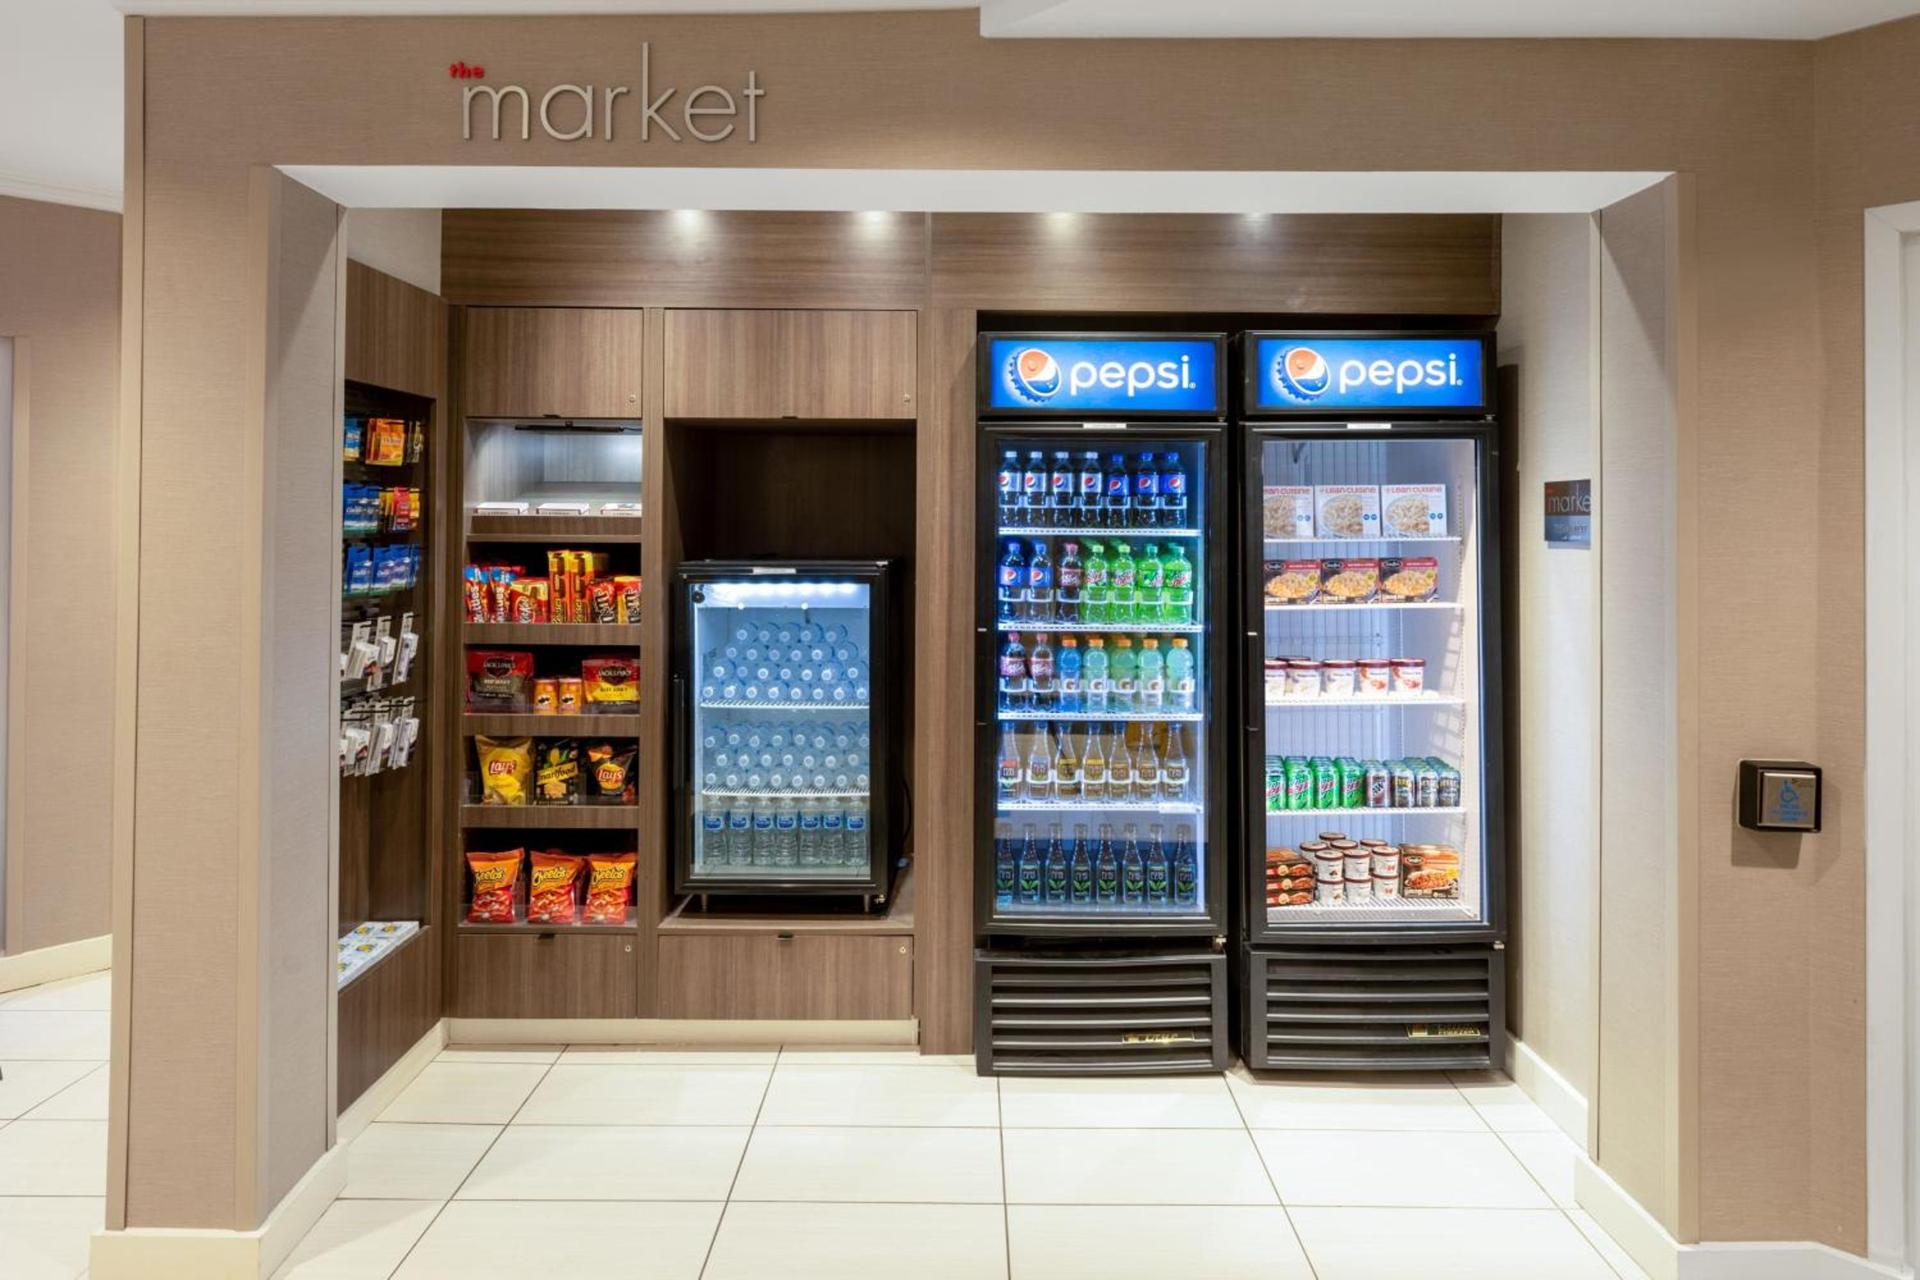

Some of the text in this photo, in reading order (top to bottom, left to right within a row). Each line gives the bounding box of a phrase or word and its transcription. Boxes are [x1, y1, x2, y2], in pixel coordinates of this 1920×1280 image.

[450, 61, 485, 79] the
[463, 41, 765, 142] market
[1070, 355, 1190, 397] pepsi
[1340, 353, 1457, 394] pepsi
[598, 767, 623, 784] Lay's
